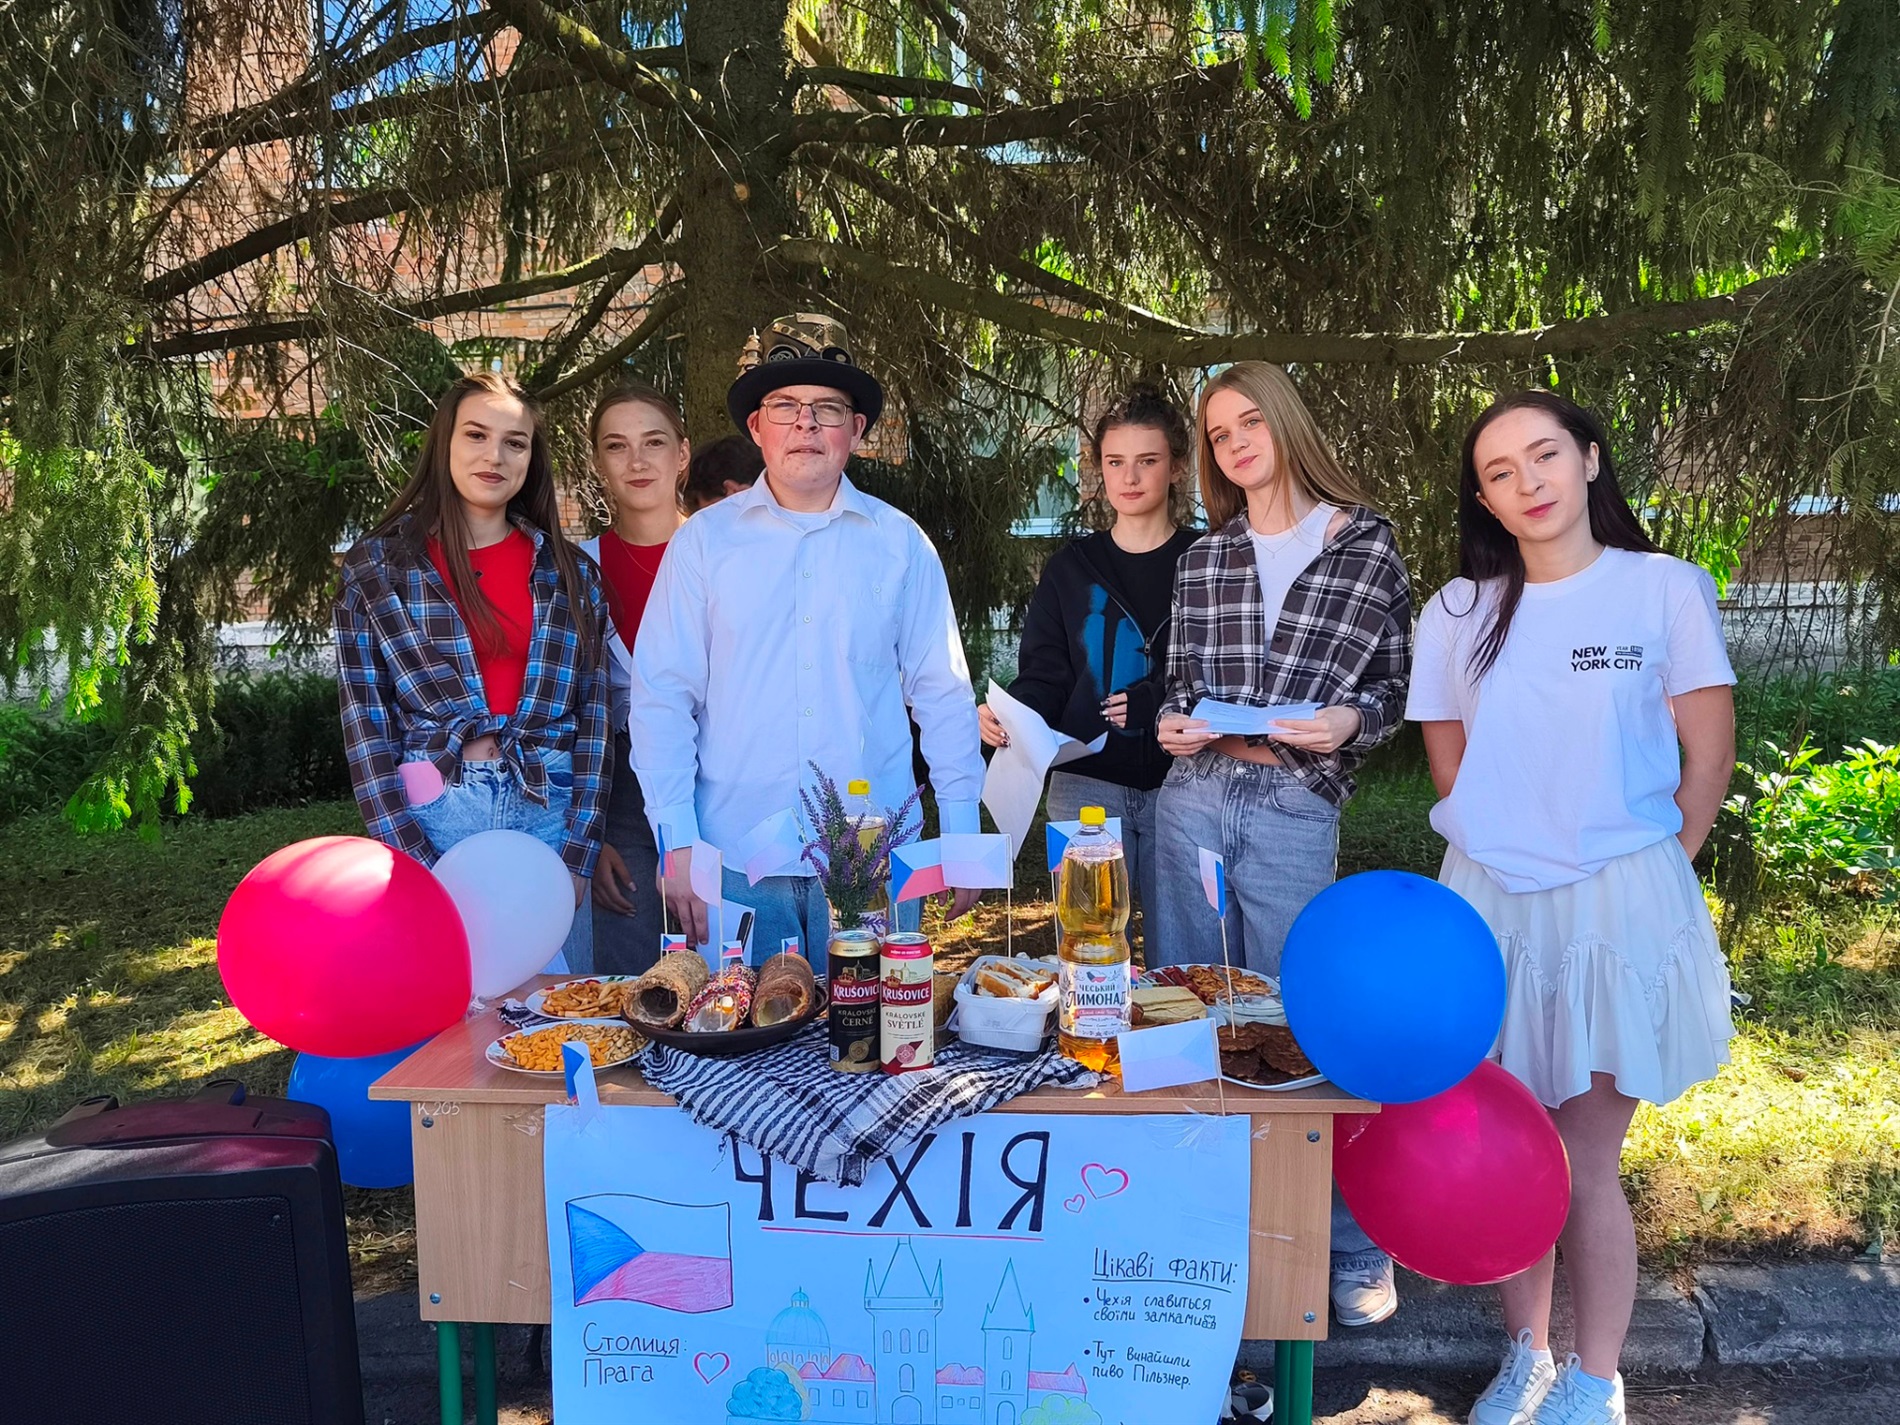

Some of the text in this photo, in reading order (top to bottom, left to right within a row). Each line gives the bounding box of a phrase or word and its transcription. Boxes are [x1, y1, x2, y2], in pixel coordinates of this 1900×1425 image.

[1572, 645, 1607, 659] NEW
[1570, 658, 1643, 672] YORK CITY
[883, 986, 929, 1002] KRUŠOVICE
[1079, 983, 1115, 992] ЧЕСЬКИЙ
[1066, 992, 1126, 1007] ЛИМОНАД
[432, 1101, 461, 1116] 205
[1093, 1247, 1155, 1279] Цікаві
[1096, 1287, 1212, 1311] Чехія славиться
[1093, 1307, 1202, 1328] своїми замками
[1092, 1340, 1191, 1368] Тут винайшли
[583, 1358, 655, 1388] Прага
[1092, 1365, 1124, 1379] пиво
